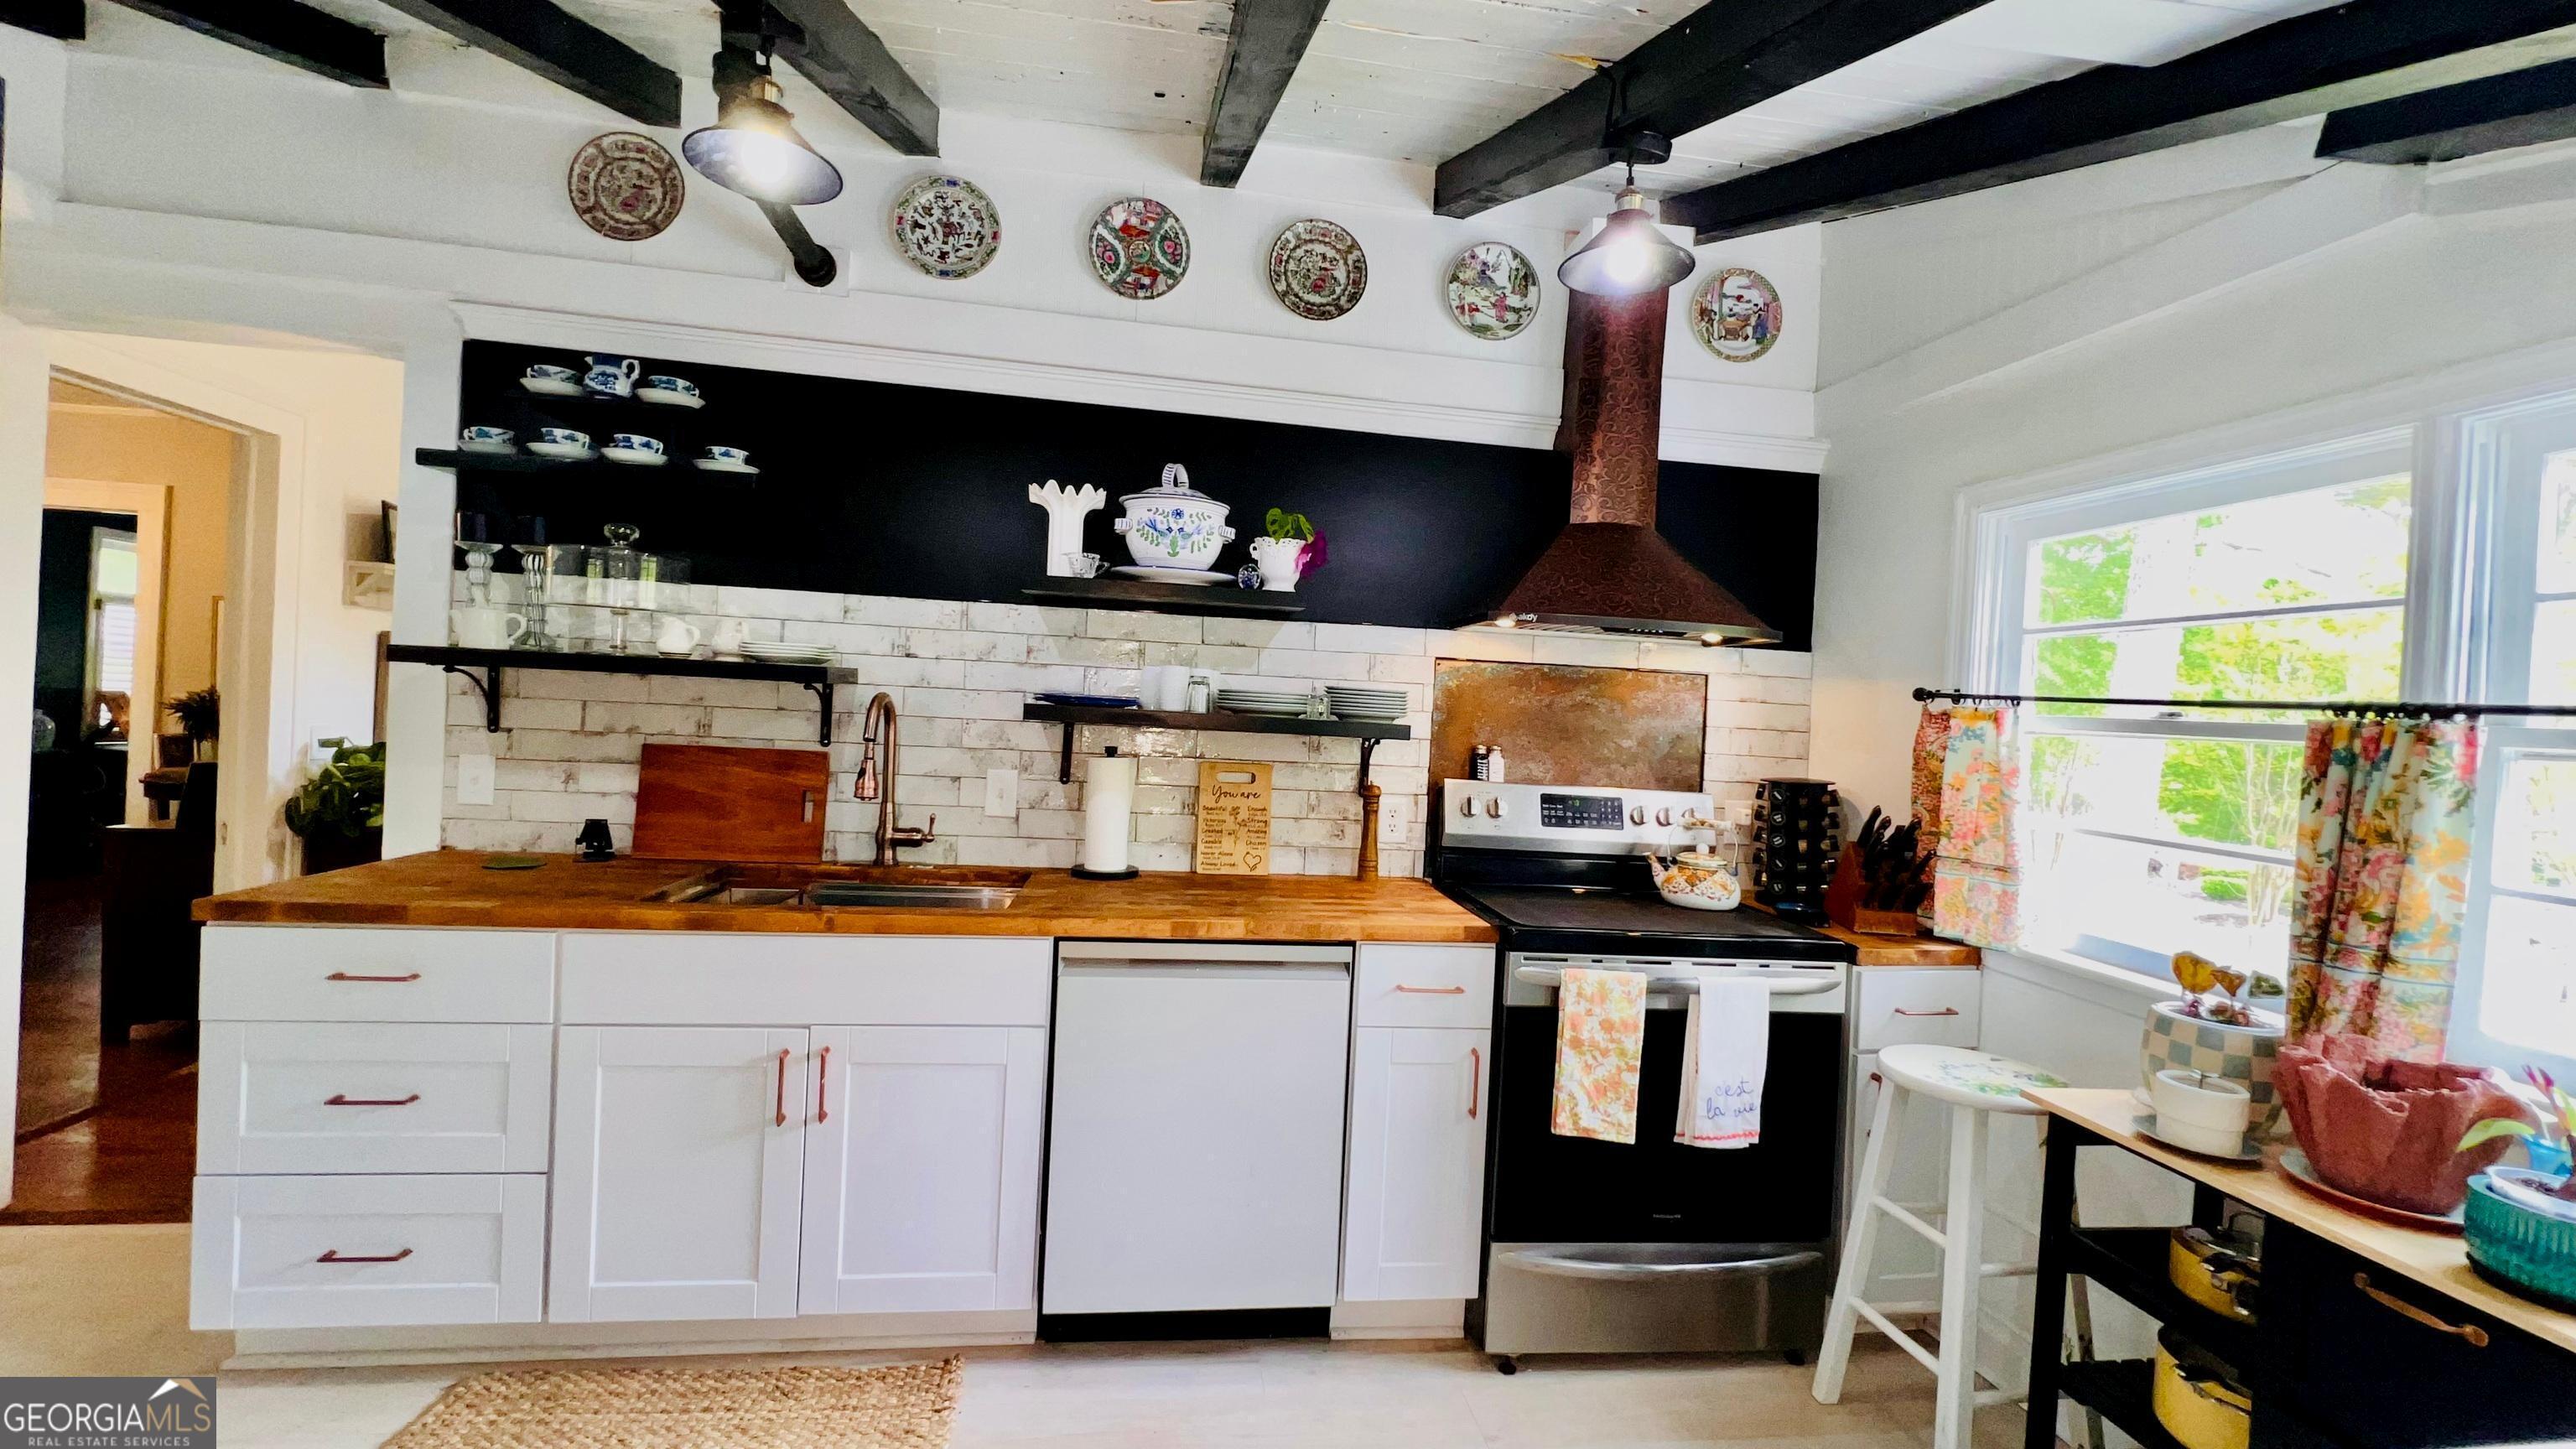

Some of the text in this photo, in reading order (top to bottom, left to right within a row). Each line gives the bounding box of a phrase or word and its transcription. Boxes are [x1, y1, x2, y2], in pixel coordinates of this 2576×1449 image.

[1213, 784, 1260, 803] You are
[1247, 818, 1268, 828] Strong
[1715, 1077, 1754, 1097] c'est
[1706, 1097, 1758, 1119] la vie
